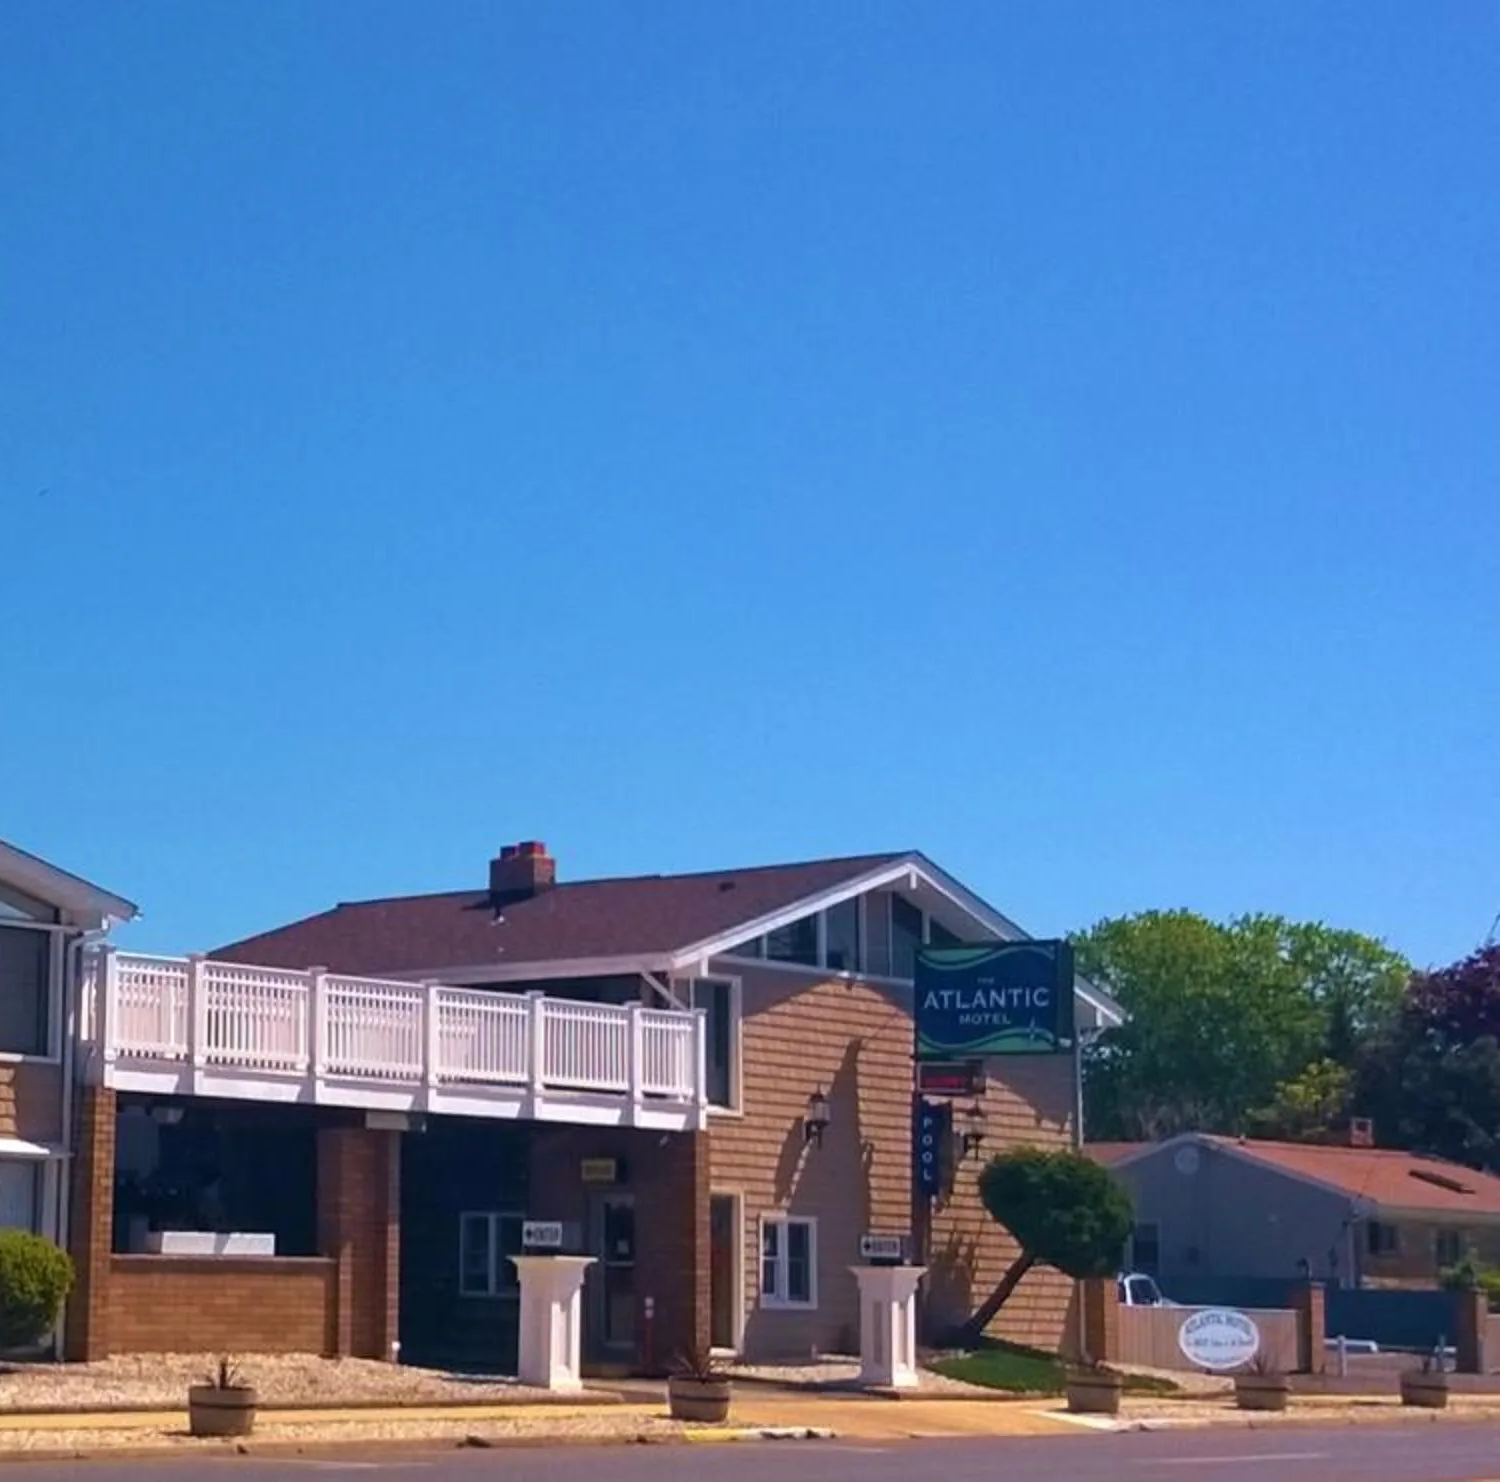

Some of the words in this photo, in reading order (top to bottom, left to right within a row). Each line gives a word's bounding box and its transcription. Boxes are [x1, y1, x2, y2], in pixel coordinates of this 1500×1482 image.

[923, 986, 1050, 1010] ATLANTIC
[958, 1012, 1012, 1026] MOTEL
[922, 1117, 933, 1182] POOL
